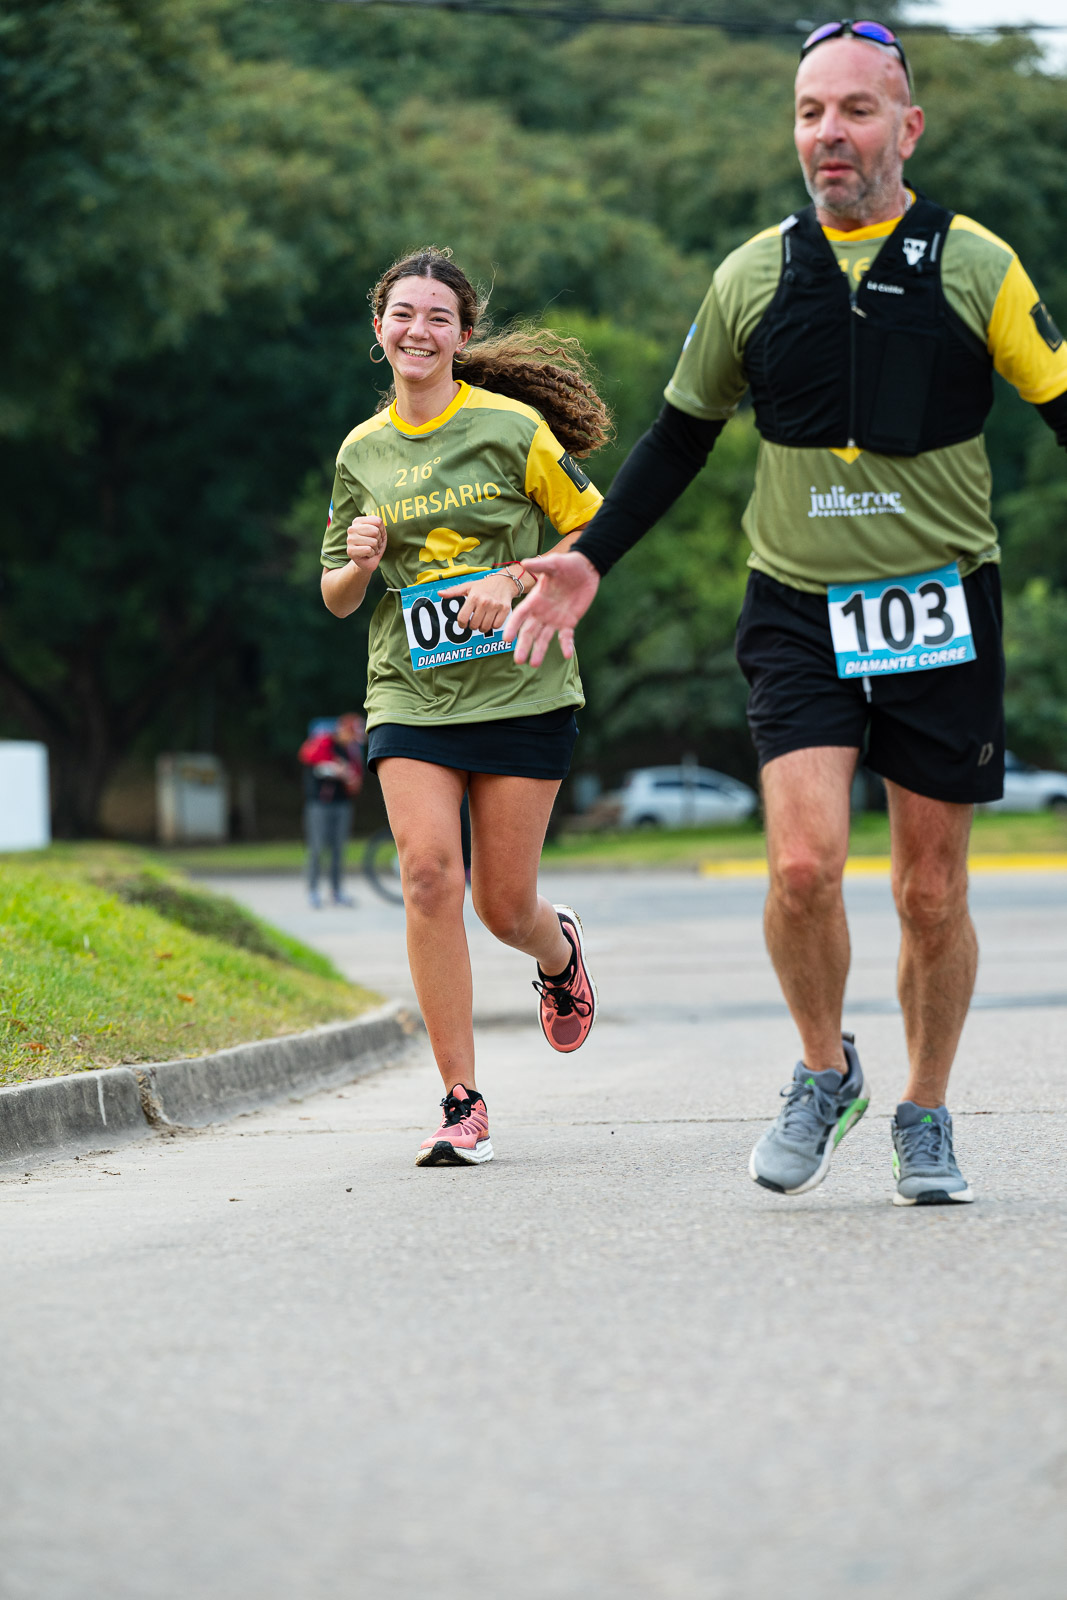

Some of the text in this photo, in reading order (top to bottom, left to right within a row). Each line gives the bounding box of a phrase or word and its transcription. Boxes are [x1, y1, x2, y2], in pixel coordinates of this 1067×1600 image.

[394, 456, 442, 488] 216°
[366, 482, 502, 527] IVERSARIO
[410, 596, 495, 651] 08
[841, 581, 955, 655] 103
[417, 640, 512, 667] DIAMANTE CORRE
[845, 646, 967, 675] DIAMANTE CORRE
